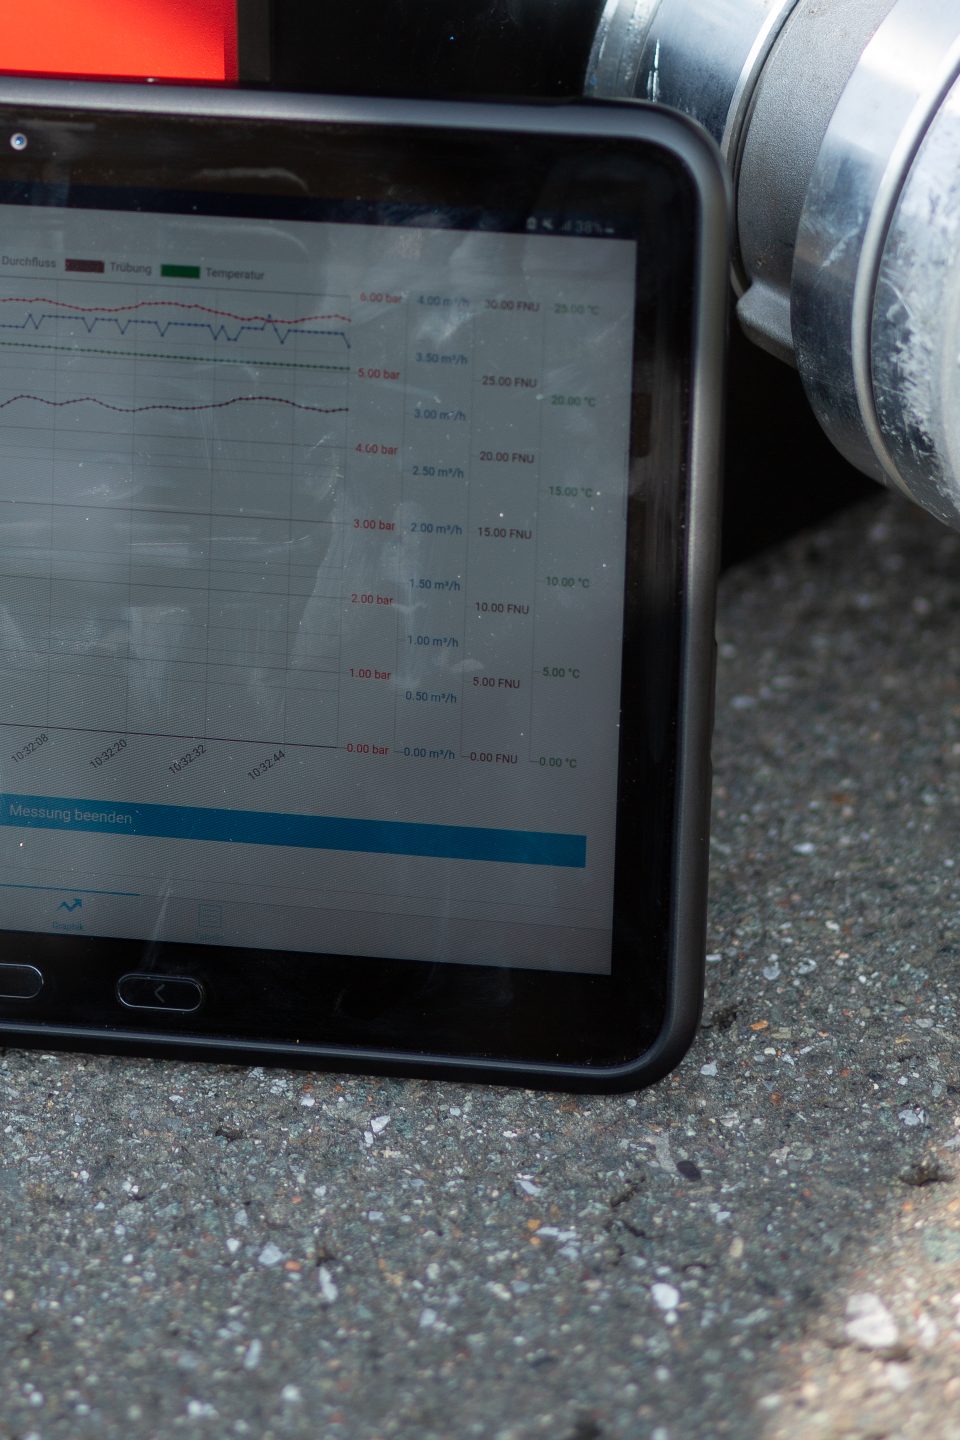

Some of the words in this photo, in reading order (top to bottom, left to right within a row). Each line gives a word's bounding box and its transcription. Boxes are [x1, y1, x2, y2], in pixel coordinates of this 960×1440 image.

[1, 256, 57, 269] Durchfluss
[110, 261, 152, 276] Trübung
[206, 267, 264, 282] Temperatur
[360, 293, 382, 302] 6.00
[384, 294, 401, 304] bar
[417, 296, 440, 306] 4.00
[517, 301, 539, 312] FNU
[416, 353, 439, 363] 3.50
[358, 368, 381, 379] 5.00
[383, 369, 400, 380] bar
[482, 376, 512, 387] 25.00
[514, 378, 537, 388] FNU
[414, 409, 436, 419] 3.00
[356, 443, 378, 454] 4.00
[380, 445, 398, 456] bar
[480, 452, 509, 462] 20.00
[512, 453, 535, 464] FNU
[413, 466, 435, 476] 2.50
[549, 486, 578, 496] 15.00
[354, 519, 376, 530] 3.00
[379, 521, 395, 531] bar
[410, 523, 433, 533] 2.00
[478, 527, 506, 538] 15.00
[509, 529, 532, 539] FNU
[410, 579, 431, 589] 1.50
[546, 576, 574, 587] 10.00
[578, 578, 589, 588] °C
[351, 594, 373, 604] 2.00
[377, 595, 394, 605] bar
[475, 602, 504, 612] 10.00
[506, 603, 529, 614] FNU
[408, 636, 430, 646] 1.00
[349, 669, 372, 679] 1.00
[374, 670, 391, 680] bar
[543, 668, 565, 678] 5.00
[568, 669, 580, 679] °C
[473, 677, 495, 687] 5.00
[498, 678, 520, 689] FNU
[405, 691, 428, 701] 0.50
[10, 733, 49, 765] 10:32:08
[89, 738, 128, 770] 10:32:20
[347, 743, 370, 754] 0.00
[372, 745, 389, 755] bar
[403, 747, 426, 758] 0.00
[168, 743, 207, 776] 10:32:32
[470, 752, 492, 763] 0.00
[495, 753, 518, 764] FNU
[539, 757, 562, 767] 0.00
[565, 758, 577, 768] °C
[246, 749, 286, 782] 10:32:44
[9, 804, 71, 823] Messung
[74, 808, 132, 825] beenden
